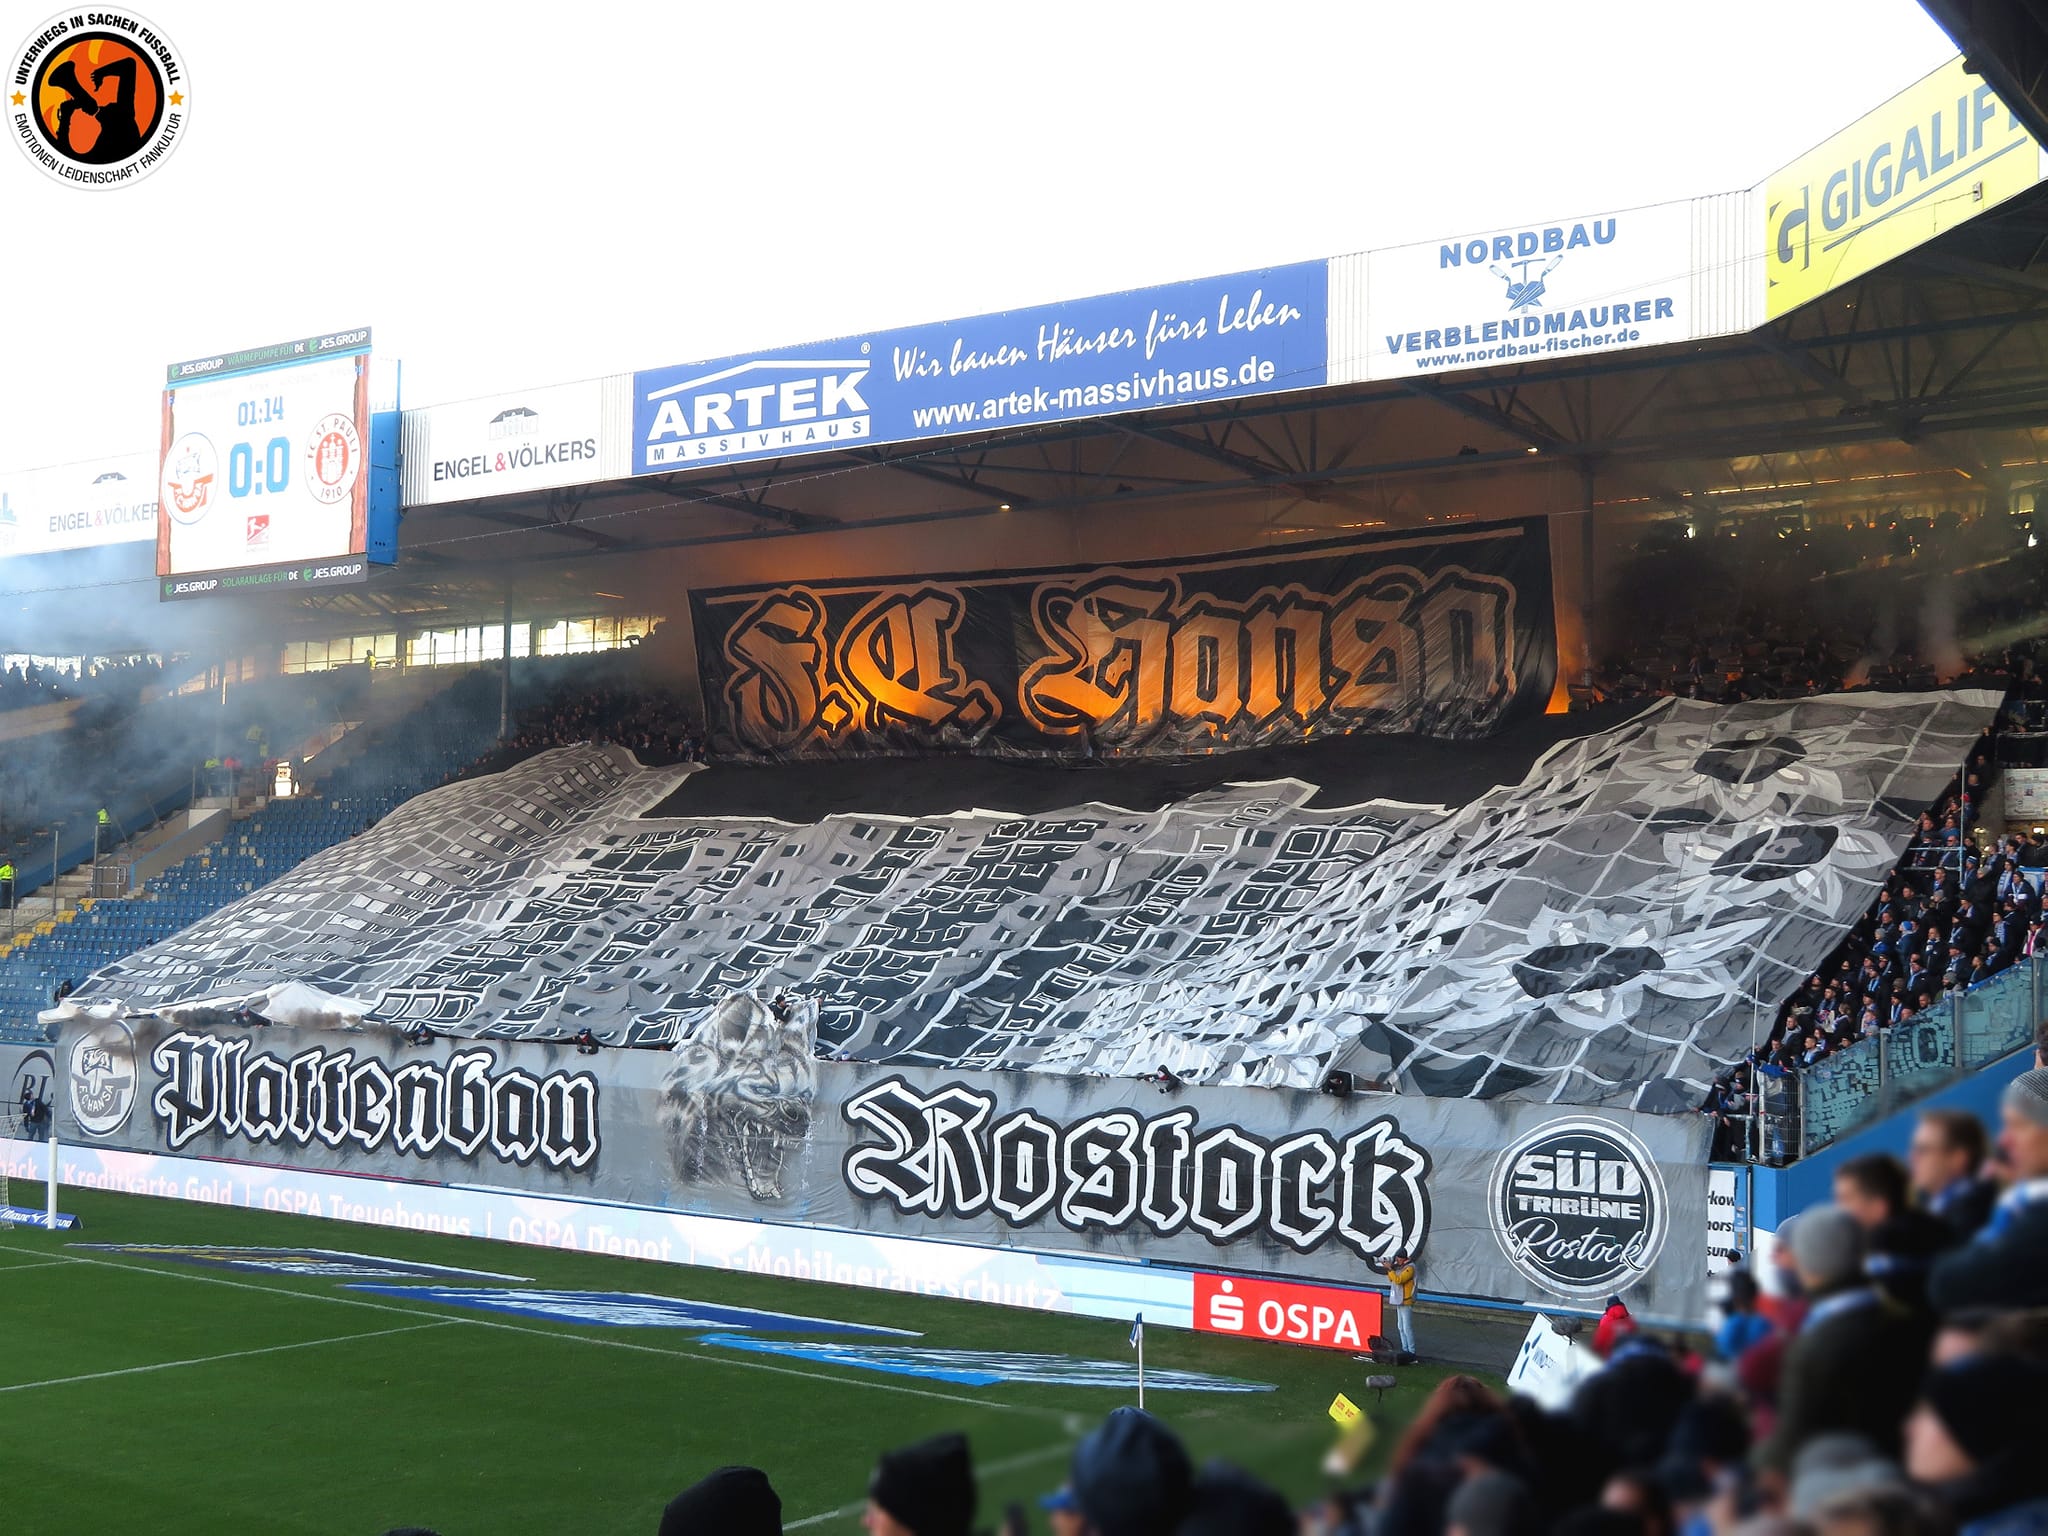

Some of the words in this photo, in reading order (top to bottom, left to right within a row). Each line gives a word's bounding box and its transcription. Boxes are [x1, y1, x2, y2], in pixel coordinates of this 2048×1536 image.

[1822, 82, 2019, 232] GIGALIF
[1440, 218, 1616, 269] NORDBAU
[892, 346, 943, 382] Wir
[949, 337, 1028, 377] bauen
[1036, 321, 1137, 363] Häuser
[1145, 309, 1207, 360] fürs
[1217, 289, 1301, 335] Leben
[1385, 297, 1674, 354] VERBLENDMAURER
[1416, 328, 1640, 368] www.nordbau-fischer.de
[179, 358, 224, 376] JES.GROUP
[318, 331, 367, 349] JES.GROUP
[238, 396, 284, 426] 01:14
[647, 370, 870, 442] ARTEK
[913, 355, 1275, 429] www.artek-massivhaus.de
[653, 420, 863, 461] MASSIVHAUS
[229, 437, 290, 498] 0:0
[320, 486, 343, 499] 1910
[174, 579, 218, 594] JES.GROUP
[313, 564, 362, 579] JES.GROUP
[152, 1029, 600, 1173] Plattenbau
[841, 1073, 1432, 1272] Rostock
[1514, 1149, 1642, 1197] SÜD
[1707, 1190, 1735, 1206] kow
[64, 1163, 178, 1196] Kreditkarte
[185, 1177, 232, 1204] Gold
[264, 1187, 323, 1216] OSPA
[329, 1194, 471, 1236] Treuebonus
[508, 1216, 578, 1250] OSPA
[1514, 1194, 1641, 1220] TRIBÜNE
[1507, 1216, 1646, 1272] Rostock
[1258, 1300, 1361, 1346] OSPA
